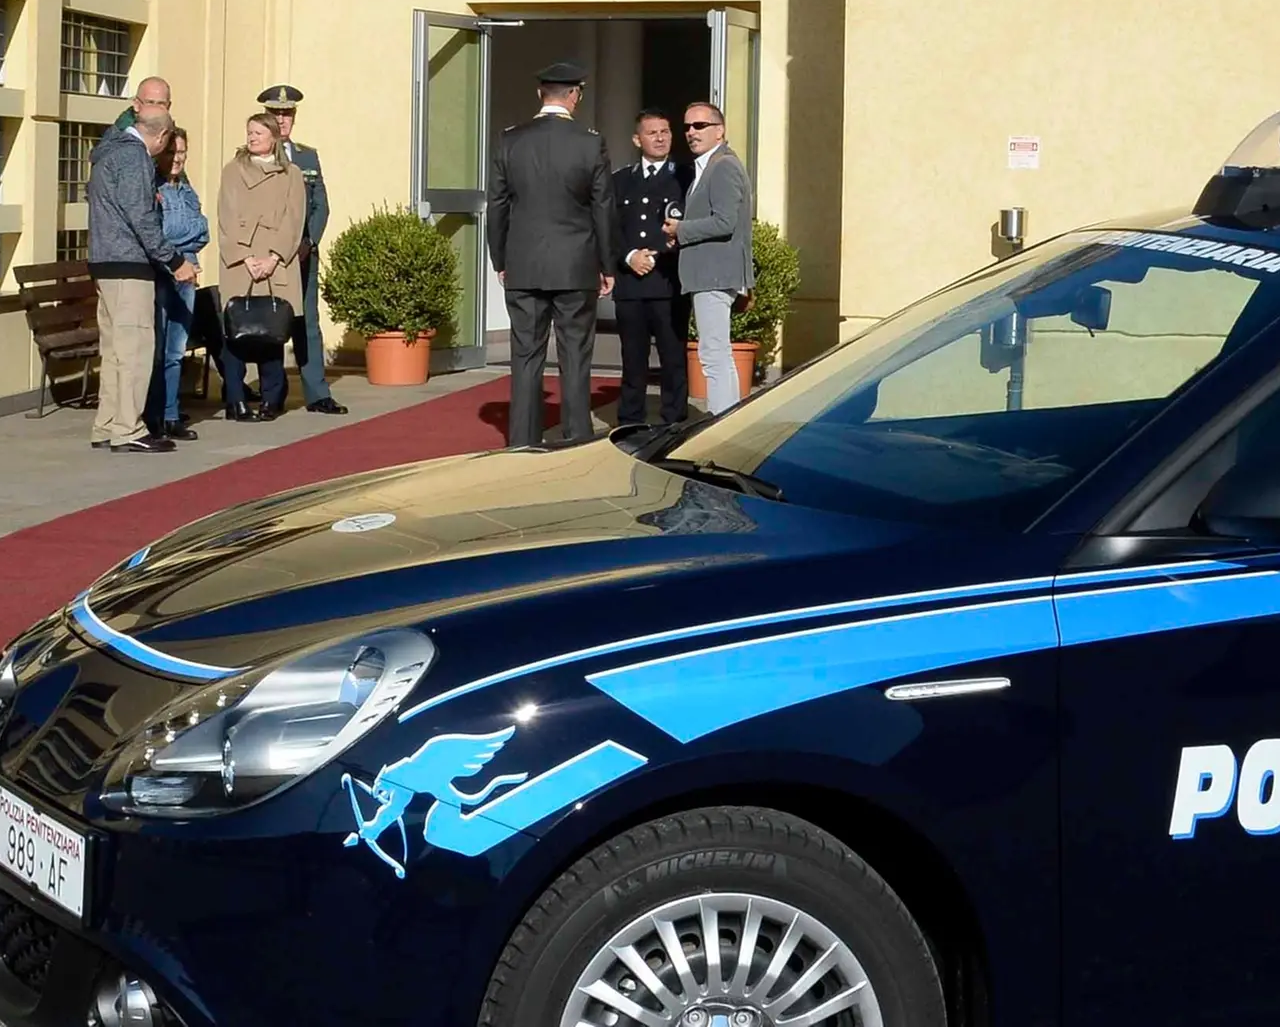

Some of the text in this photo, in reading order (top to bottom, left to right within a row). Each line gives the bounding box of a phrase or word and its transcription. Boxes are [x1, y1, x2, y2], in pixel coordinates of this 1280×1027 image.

[0, 796, 80, 862] POLIZIA PENITENZIARIA
[646, 850, 775, 881] MICHELIN
